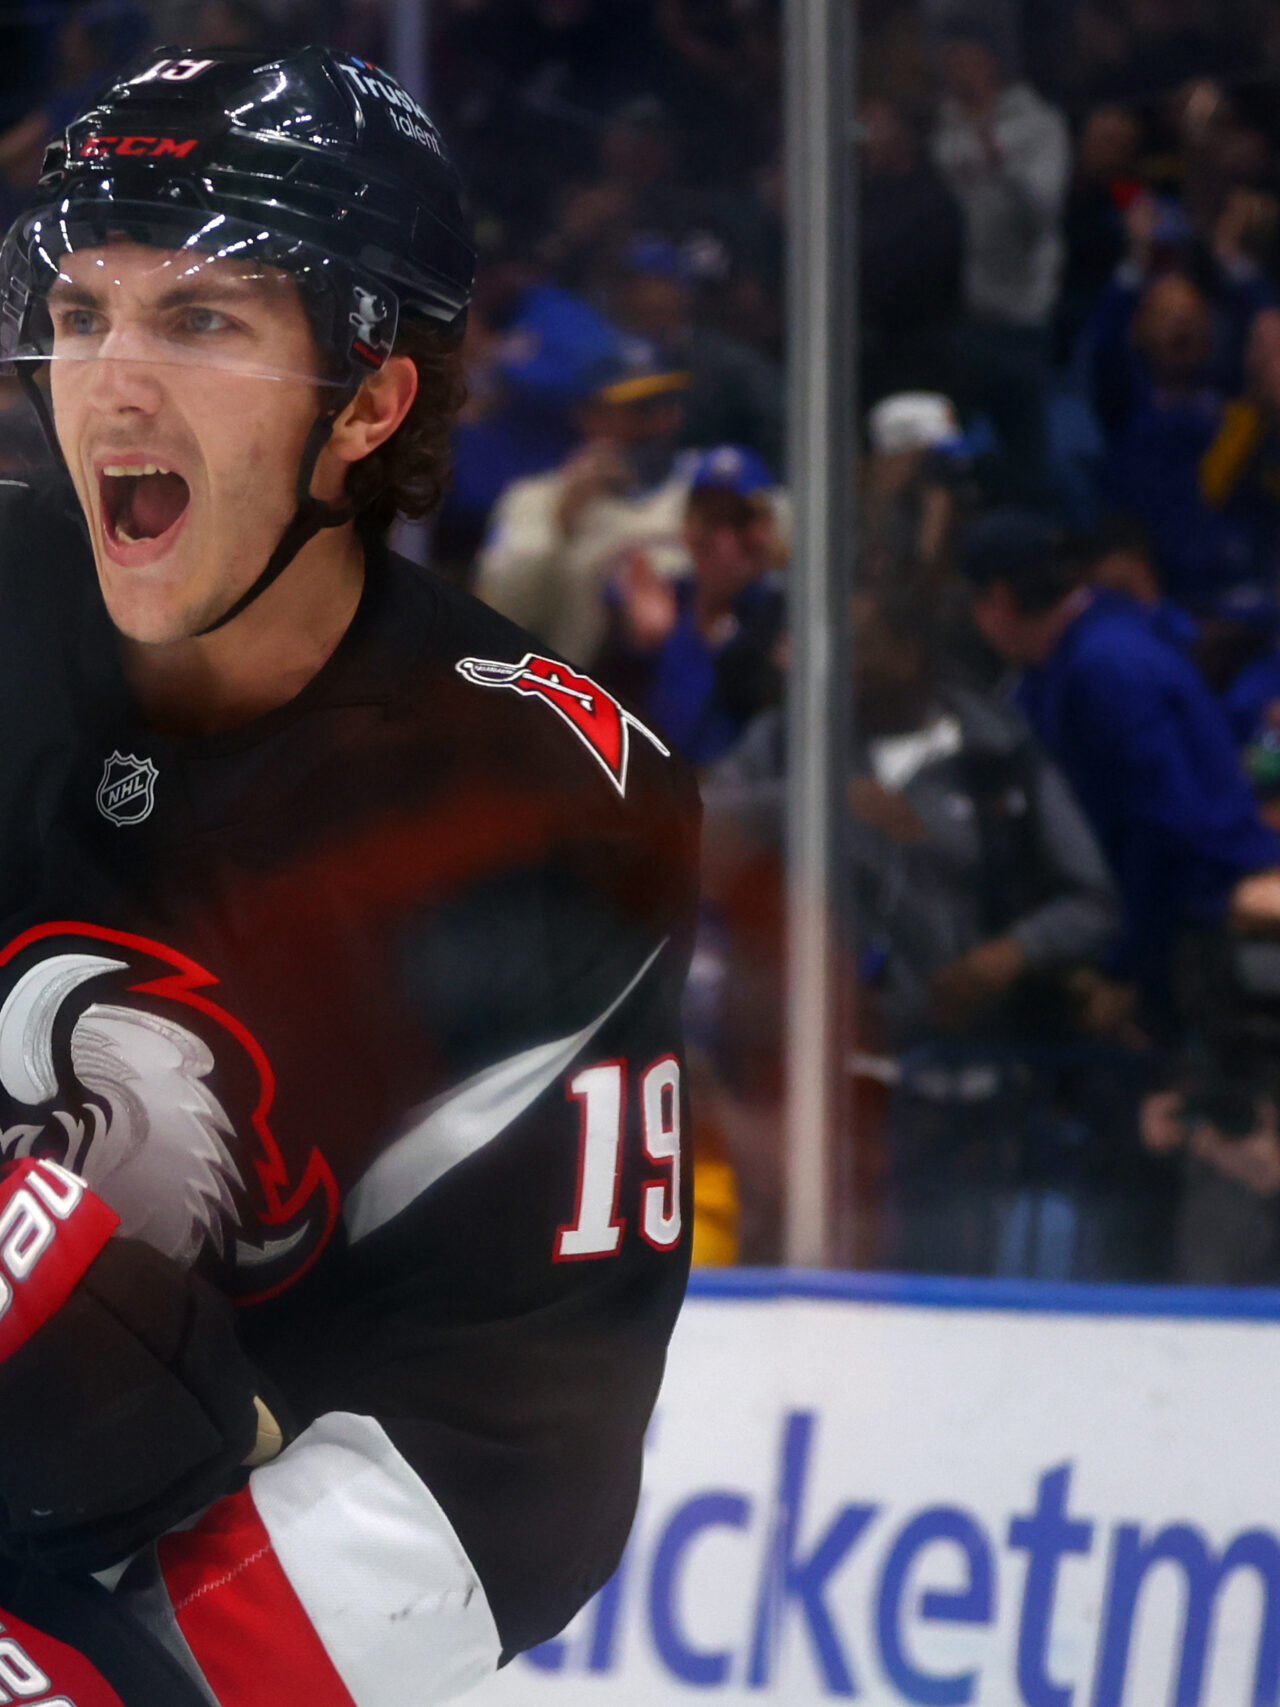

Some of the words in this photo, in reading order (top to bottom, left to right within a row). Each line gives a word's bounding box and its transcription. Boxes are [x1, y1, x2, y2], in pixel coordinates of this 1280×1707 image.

[80, 136, 198, 158] CCM
[108, 775, 144, 807] NHL
[552, 1052, 682, 1263] 19
